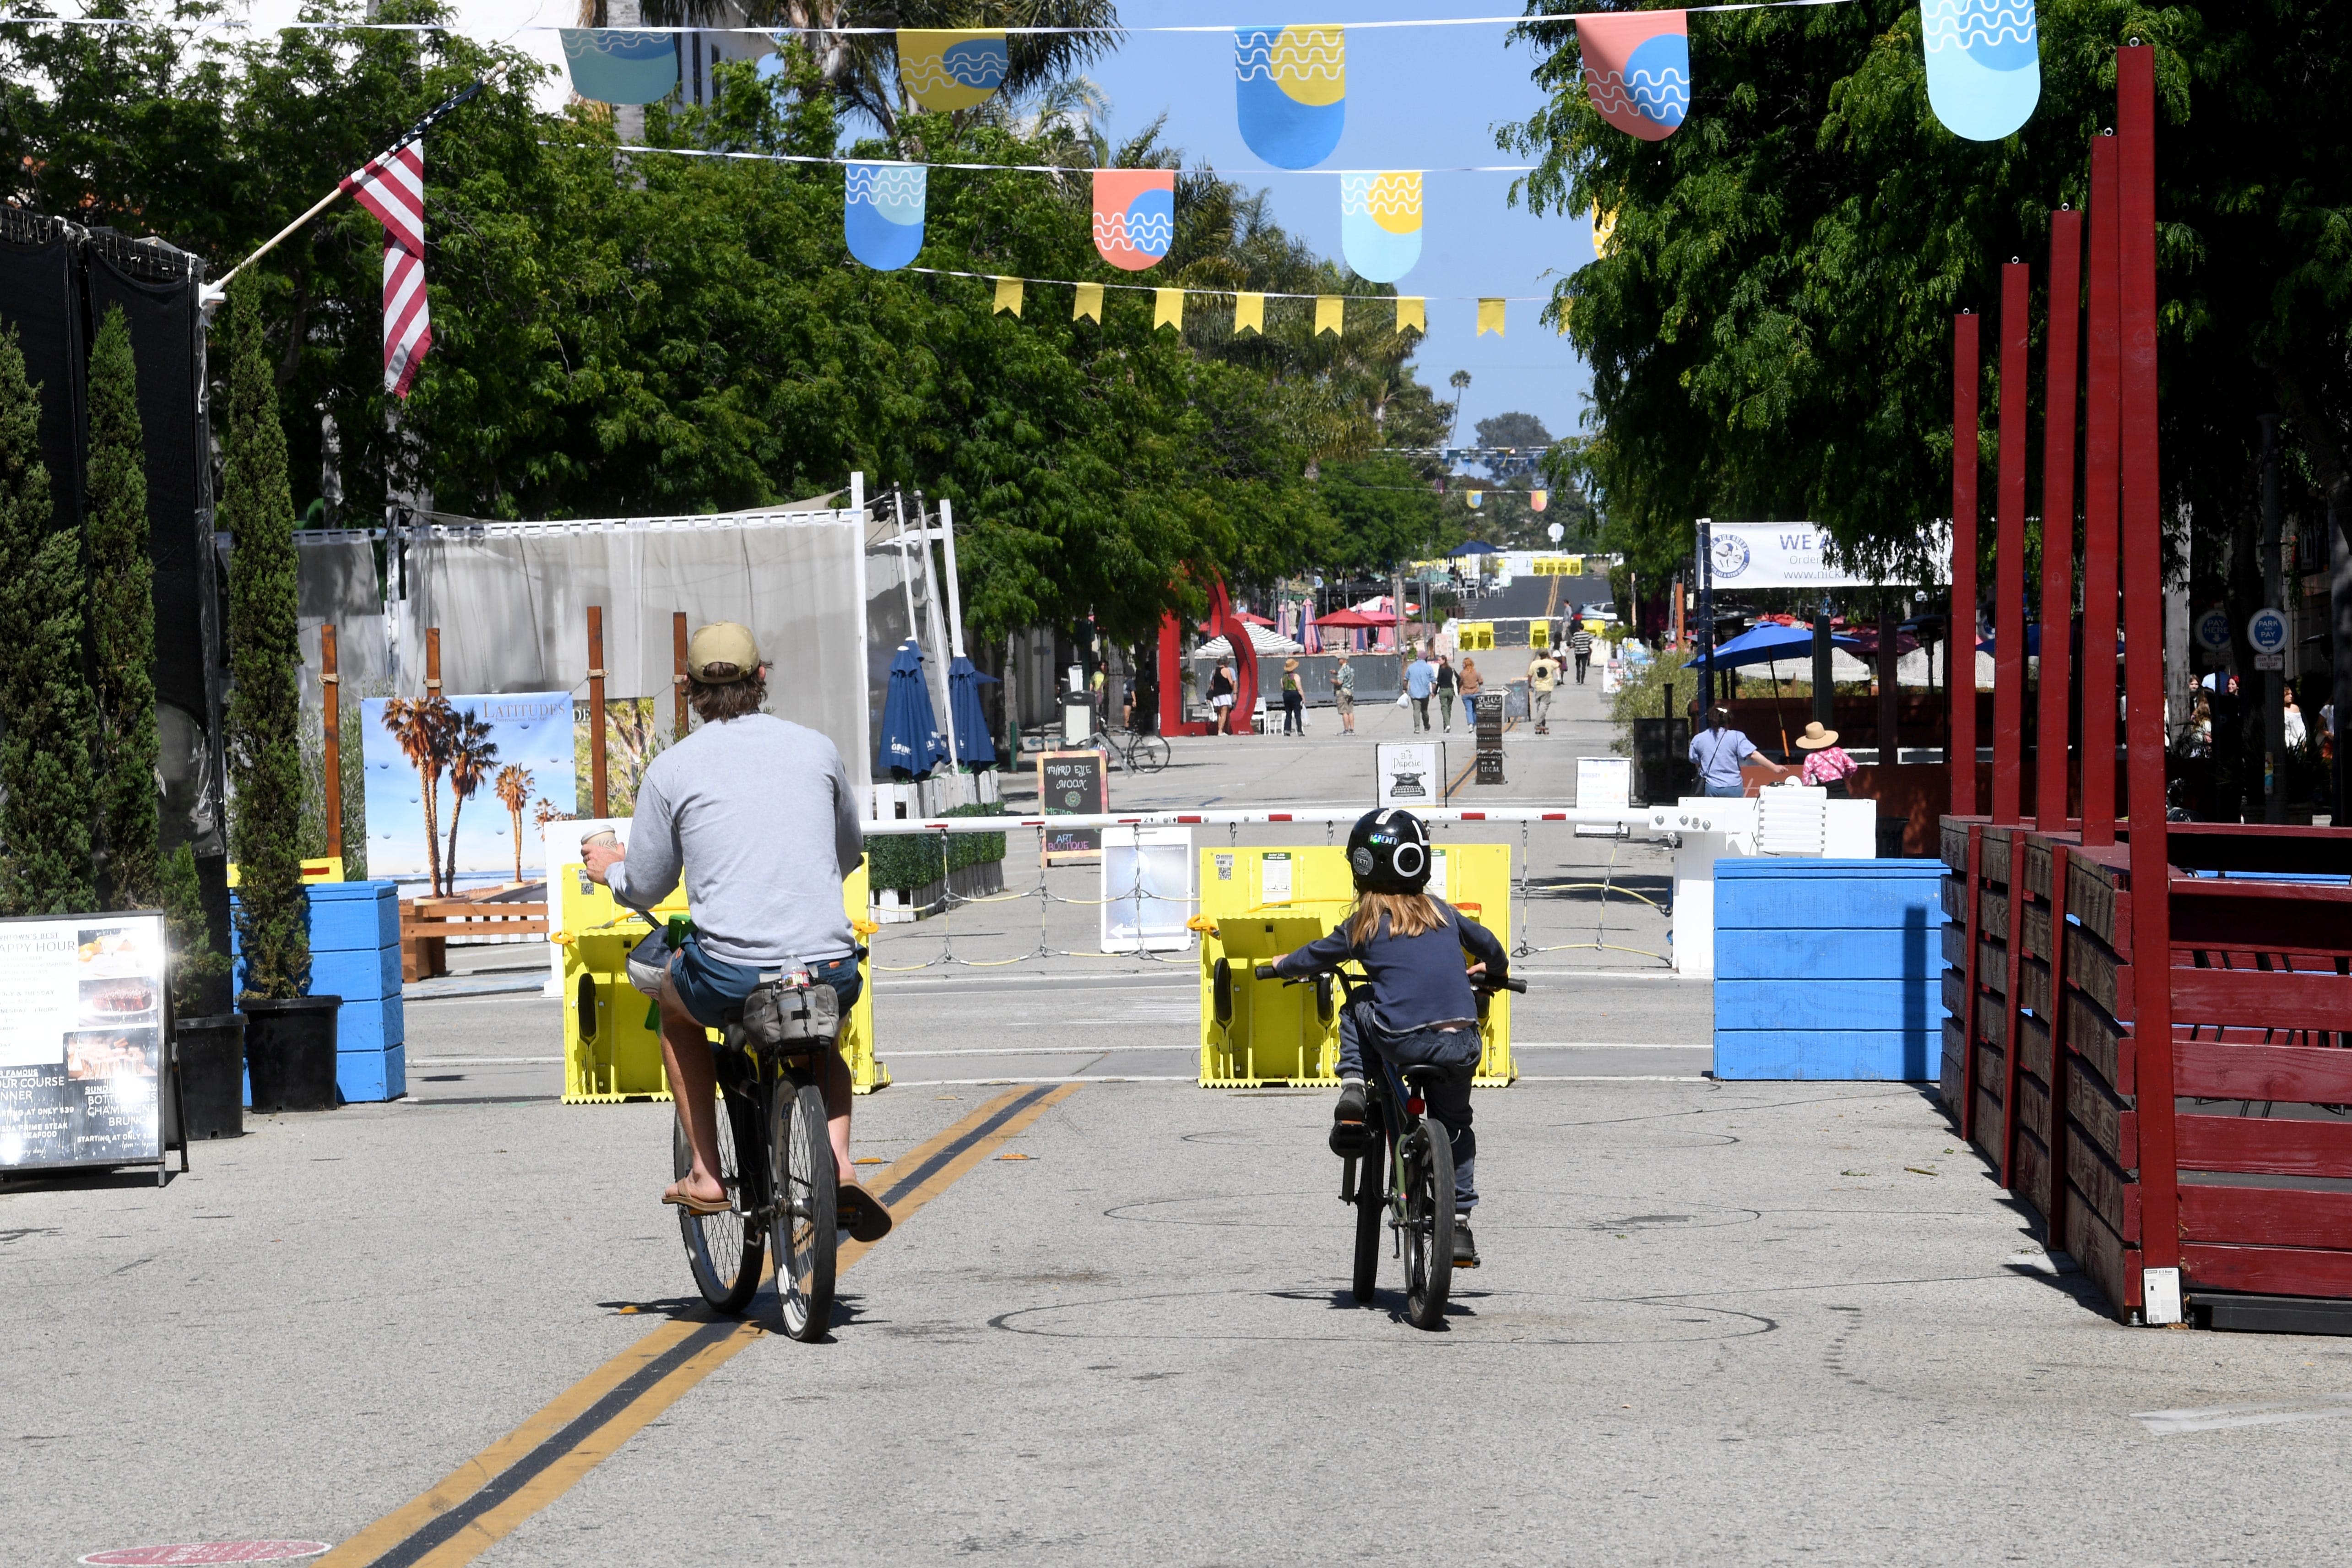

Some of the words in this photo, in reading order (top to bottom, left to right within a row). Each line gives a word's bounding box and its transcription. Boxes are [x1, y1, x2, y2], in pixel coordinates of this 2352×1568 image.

[1779, 534, 1811, 550] WE
[483, 701, 565, 718] LATITUDES
[1046, 765, 1071, 776] THIRD
[1074, 765, 1092, 777] EYE
[1056, 779, 1088, 791] MOON
[1056, 834, 1074, 843] ART
[1048, 841, 1089, 851] BOUTIQUE
[1356, 857, 1368, 866] YETI
[37, 941, 76, 953] HOUR
[6, 1069, 38, 1078] FAMOUS
[20, 1076, 65, 1088] COURSE
[44, 1122, 68, 1130] STEAK
[22, 1130, 58, 1139] SEAFOOD
[77, 1134, 110, 1143] STARTING
